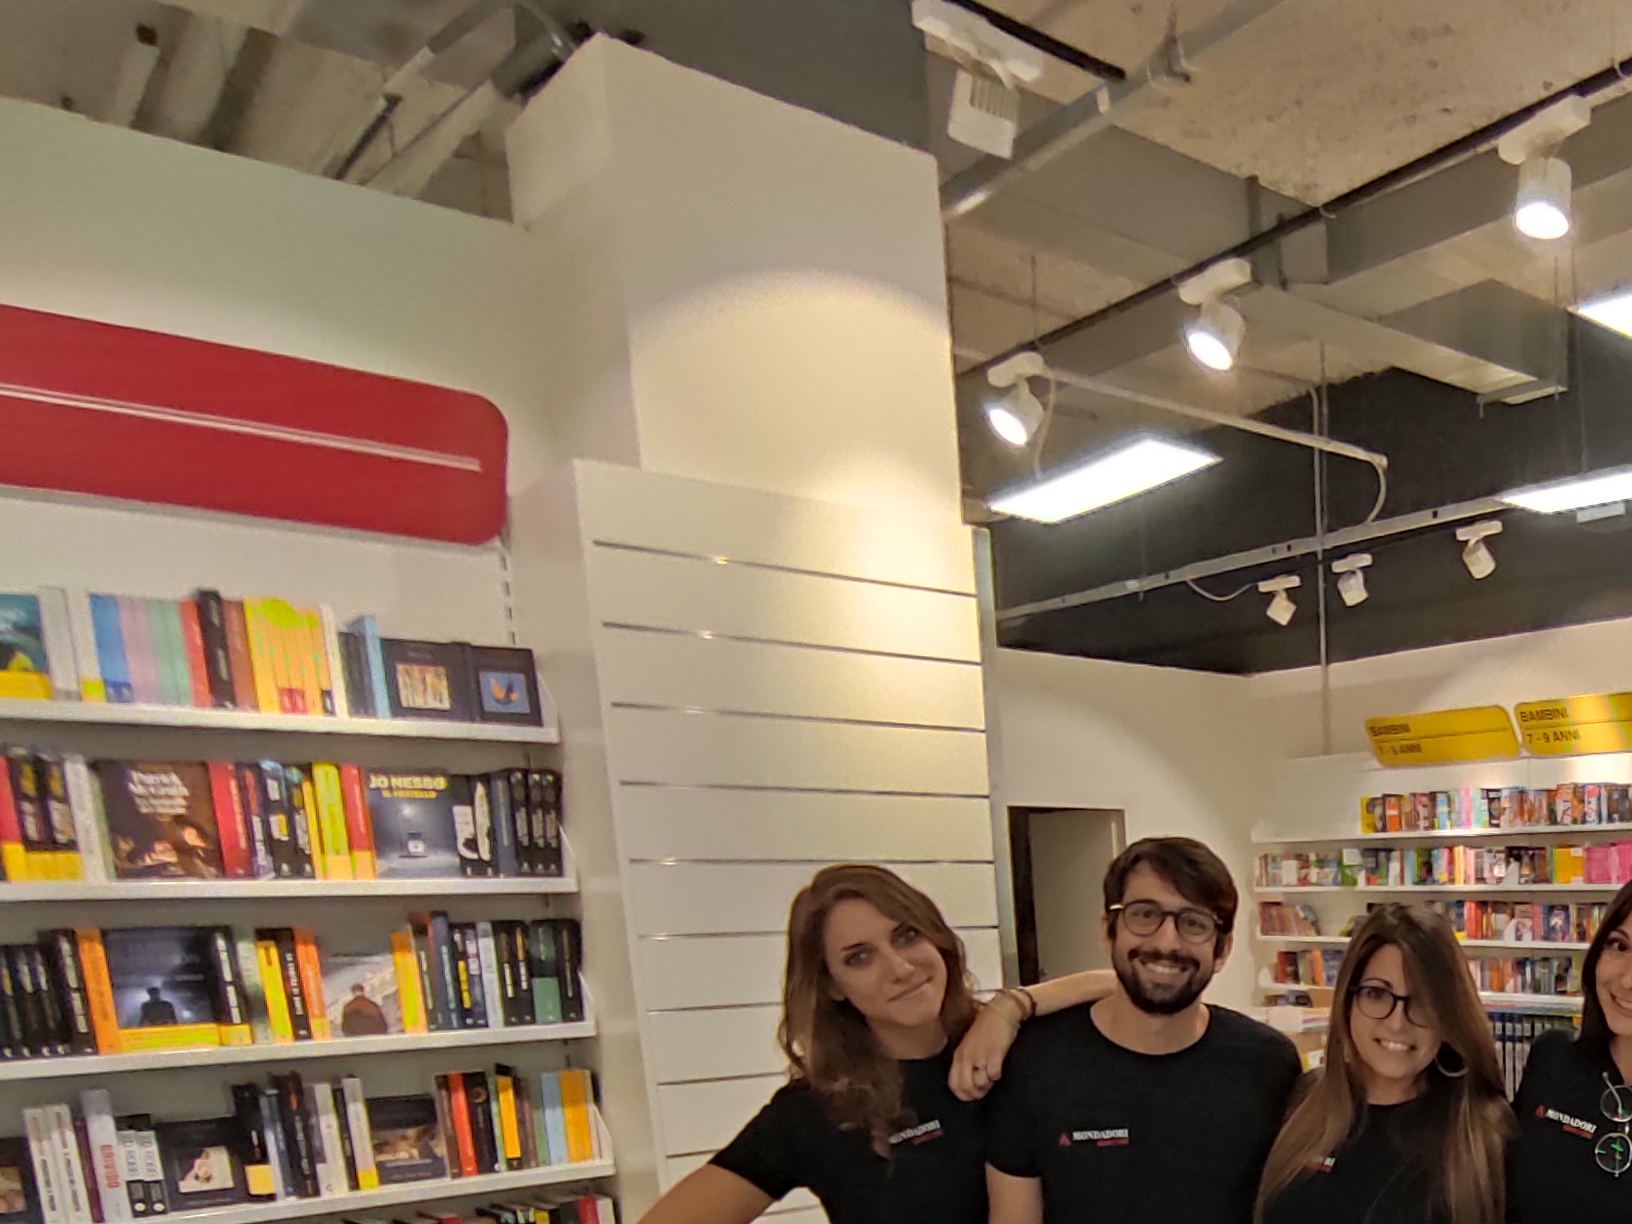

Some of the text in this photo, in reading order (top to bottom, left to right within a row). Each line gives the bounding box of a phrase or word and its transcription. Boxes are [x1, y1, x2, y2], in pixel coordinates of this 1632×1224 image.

[1520, 708, 1569, 722] BAMBINI
[1369, 723, 1411, 737] BAMBINI
[1526, 733, 1533, 744] 7
[1544, 732, 1551, 743] 9
[1553, 730, 1581, 743] ANNI
[1545, 1109, 1598, 1134] MONDADORI
[1072, 1129, 1129, 1141] MONDADORI
